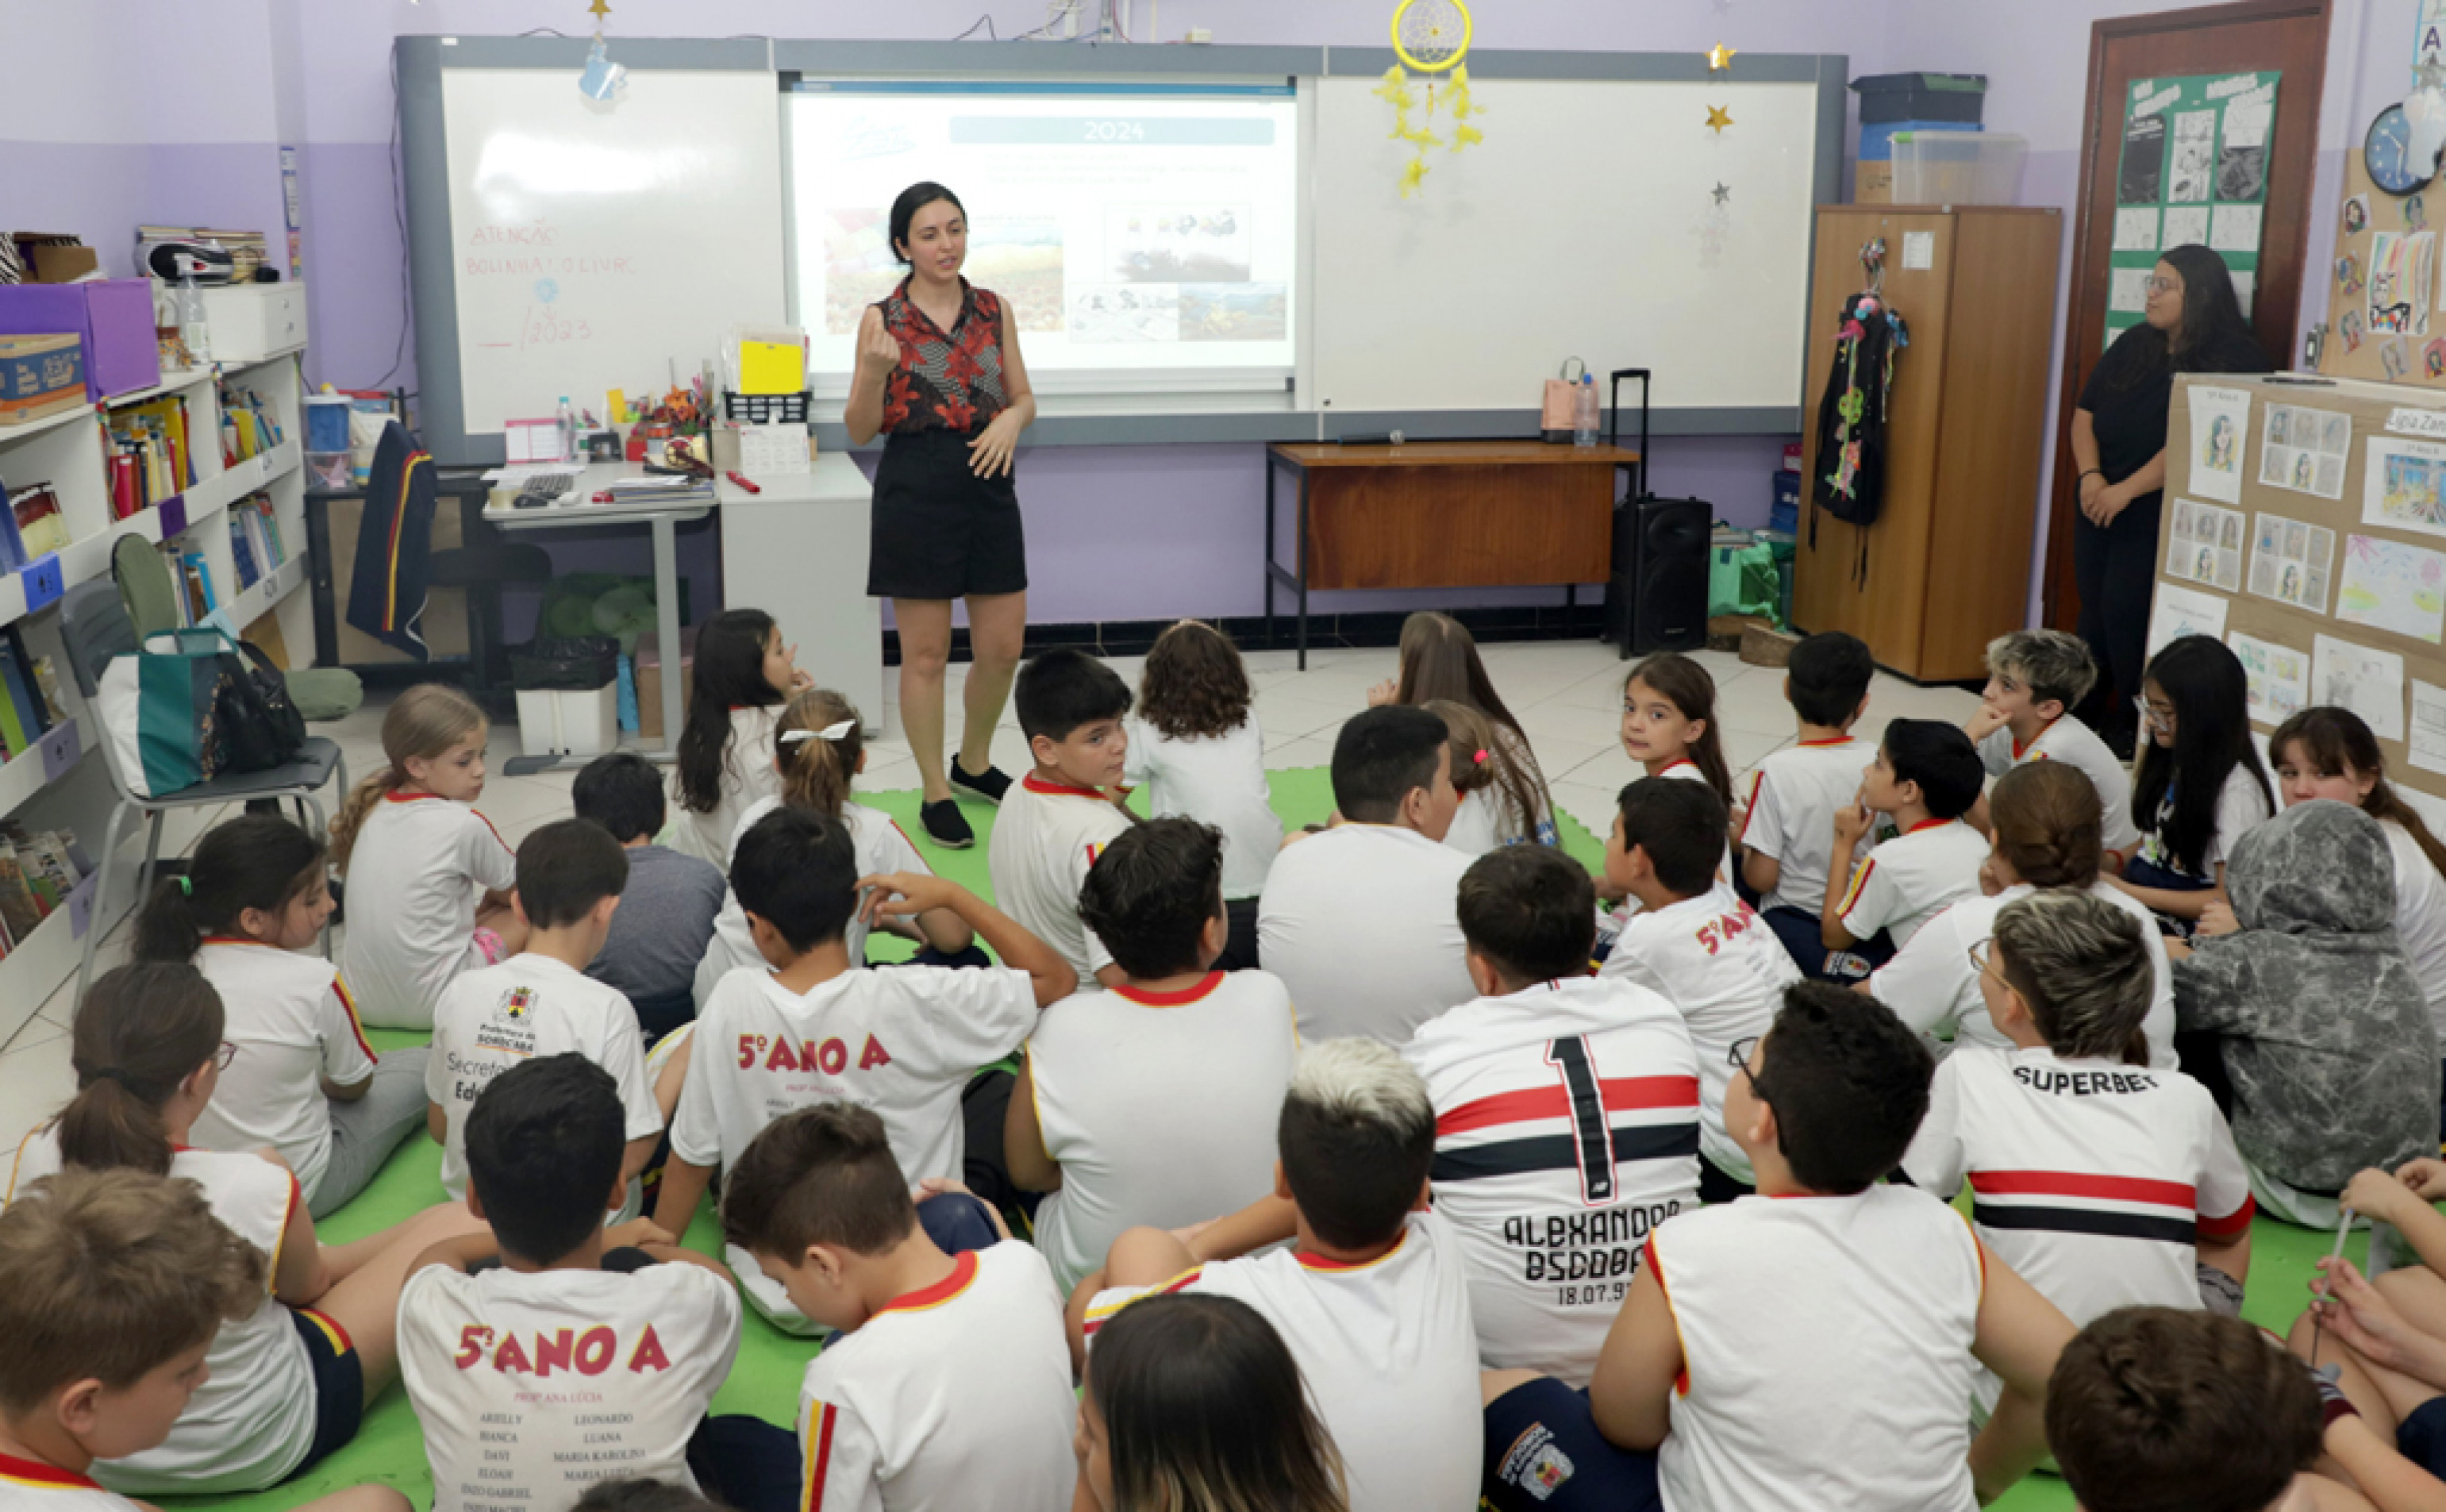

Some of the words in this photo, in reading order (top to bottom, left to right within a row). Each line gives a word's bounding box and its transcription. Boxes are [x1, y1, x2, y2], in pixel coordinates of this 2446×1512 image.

[2422, 26, 2442, 50] A
[1084, 121, 1144, 141] 2024
[857, 1031, 893, 1071] A
[1558, 1282, 1632, 1306] 18.07.9
[492, 1323, 617, 1379] ANO
[627, 1321, 672, 1375] A
[574, 1413, 634, 1426] LEONARDO
[479, 1430, 519, 1443] BIANCA
[583, 1432, 622, 1444] LUANA
[553, 1452, 590, 1463] MARIA
